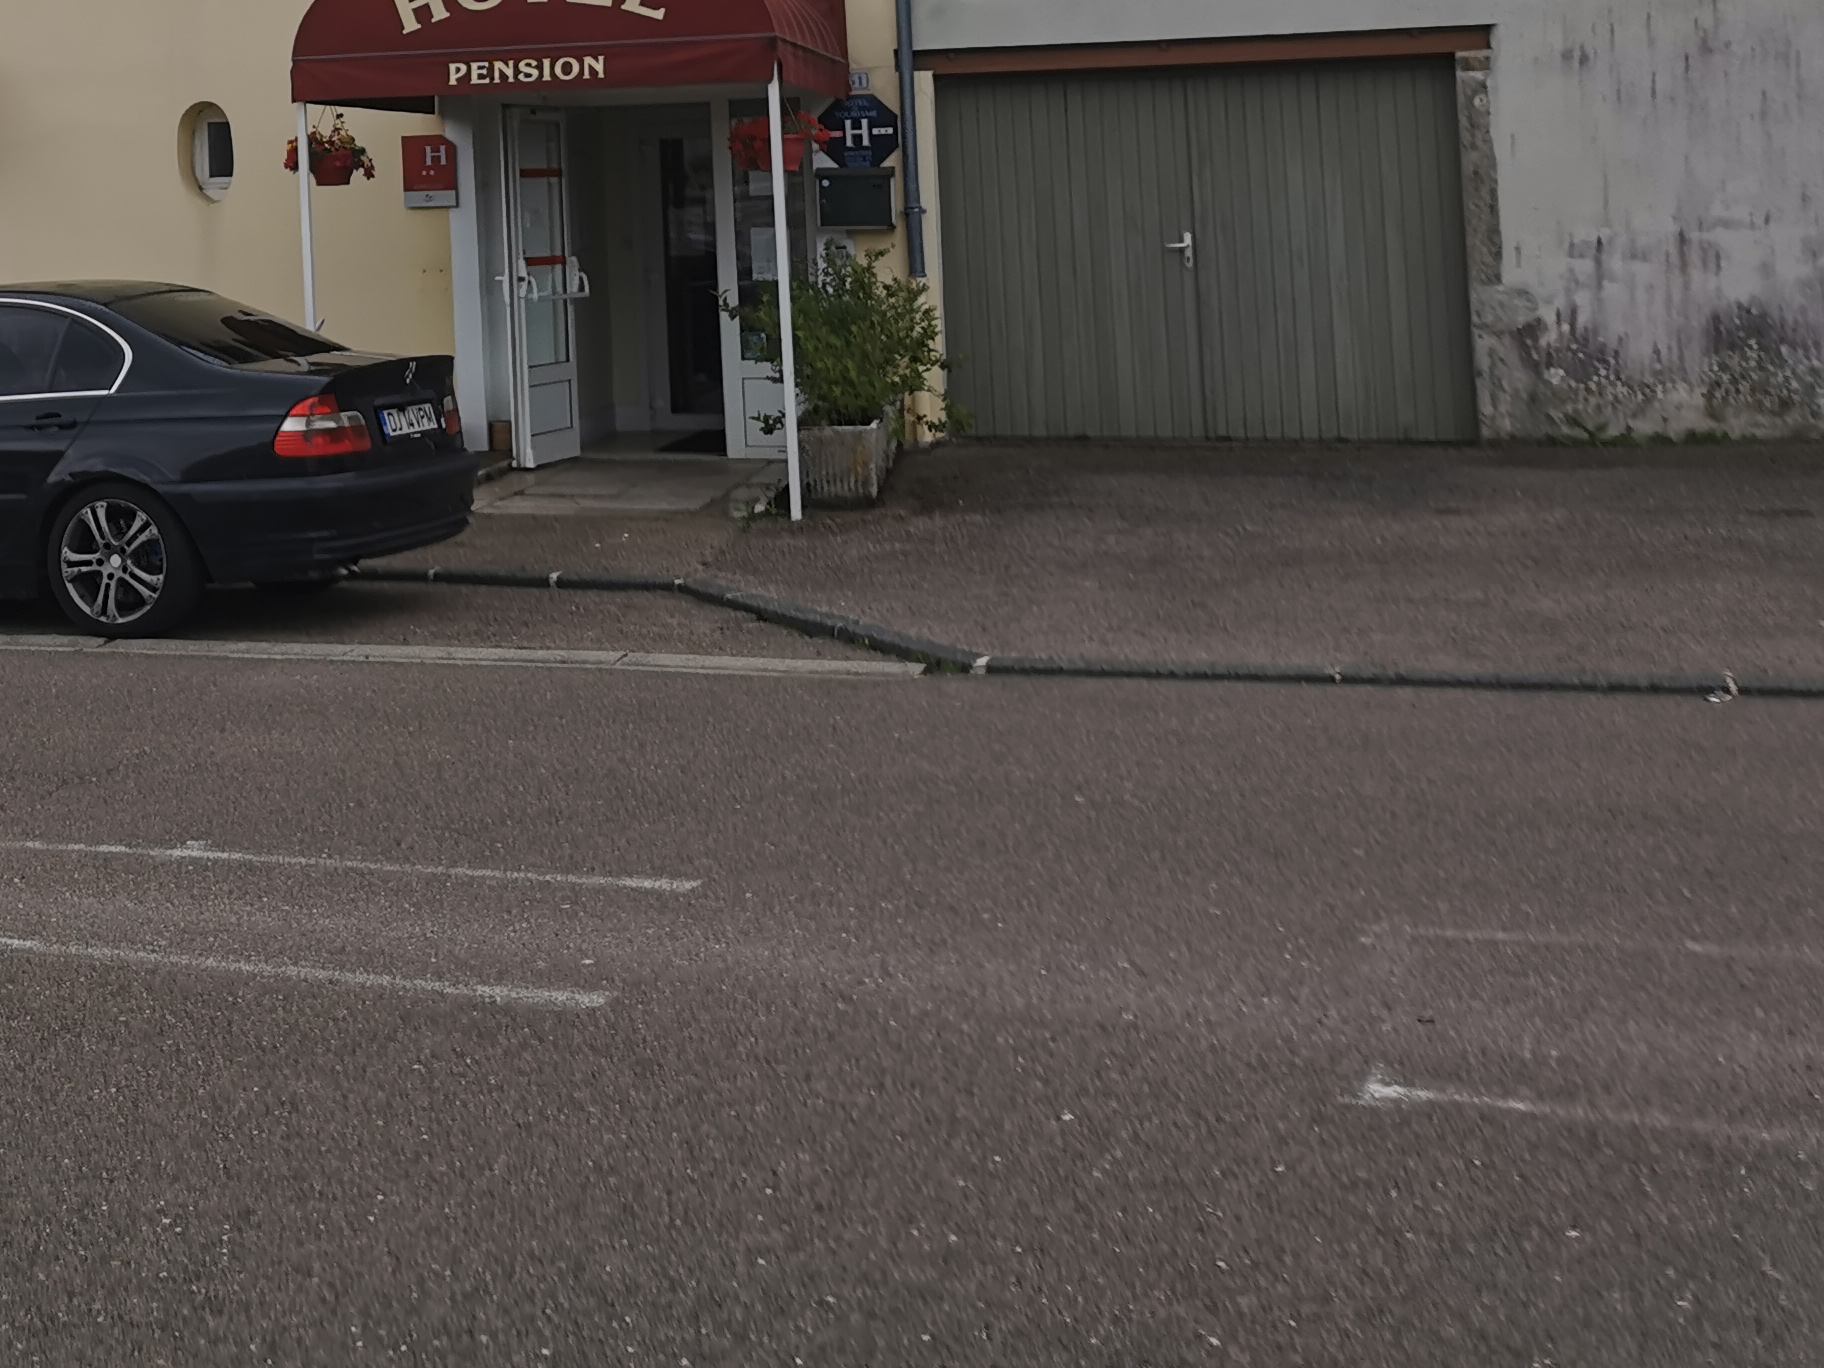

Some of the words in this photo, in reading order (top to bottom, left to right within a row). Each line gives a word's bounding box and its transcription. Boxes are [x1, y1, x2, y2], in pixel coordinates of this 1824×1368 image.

[448, 55, 606, 86] PENSION
[844, 118, 871, 148] H
[424, 145, 448, 166] H
[387, 410, 403, 433] DJ
[412, 405, 435, 429] VPM
